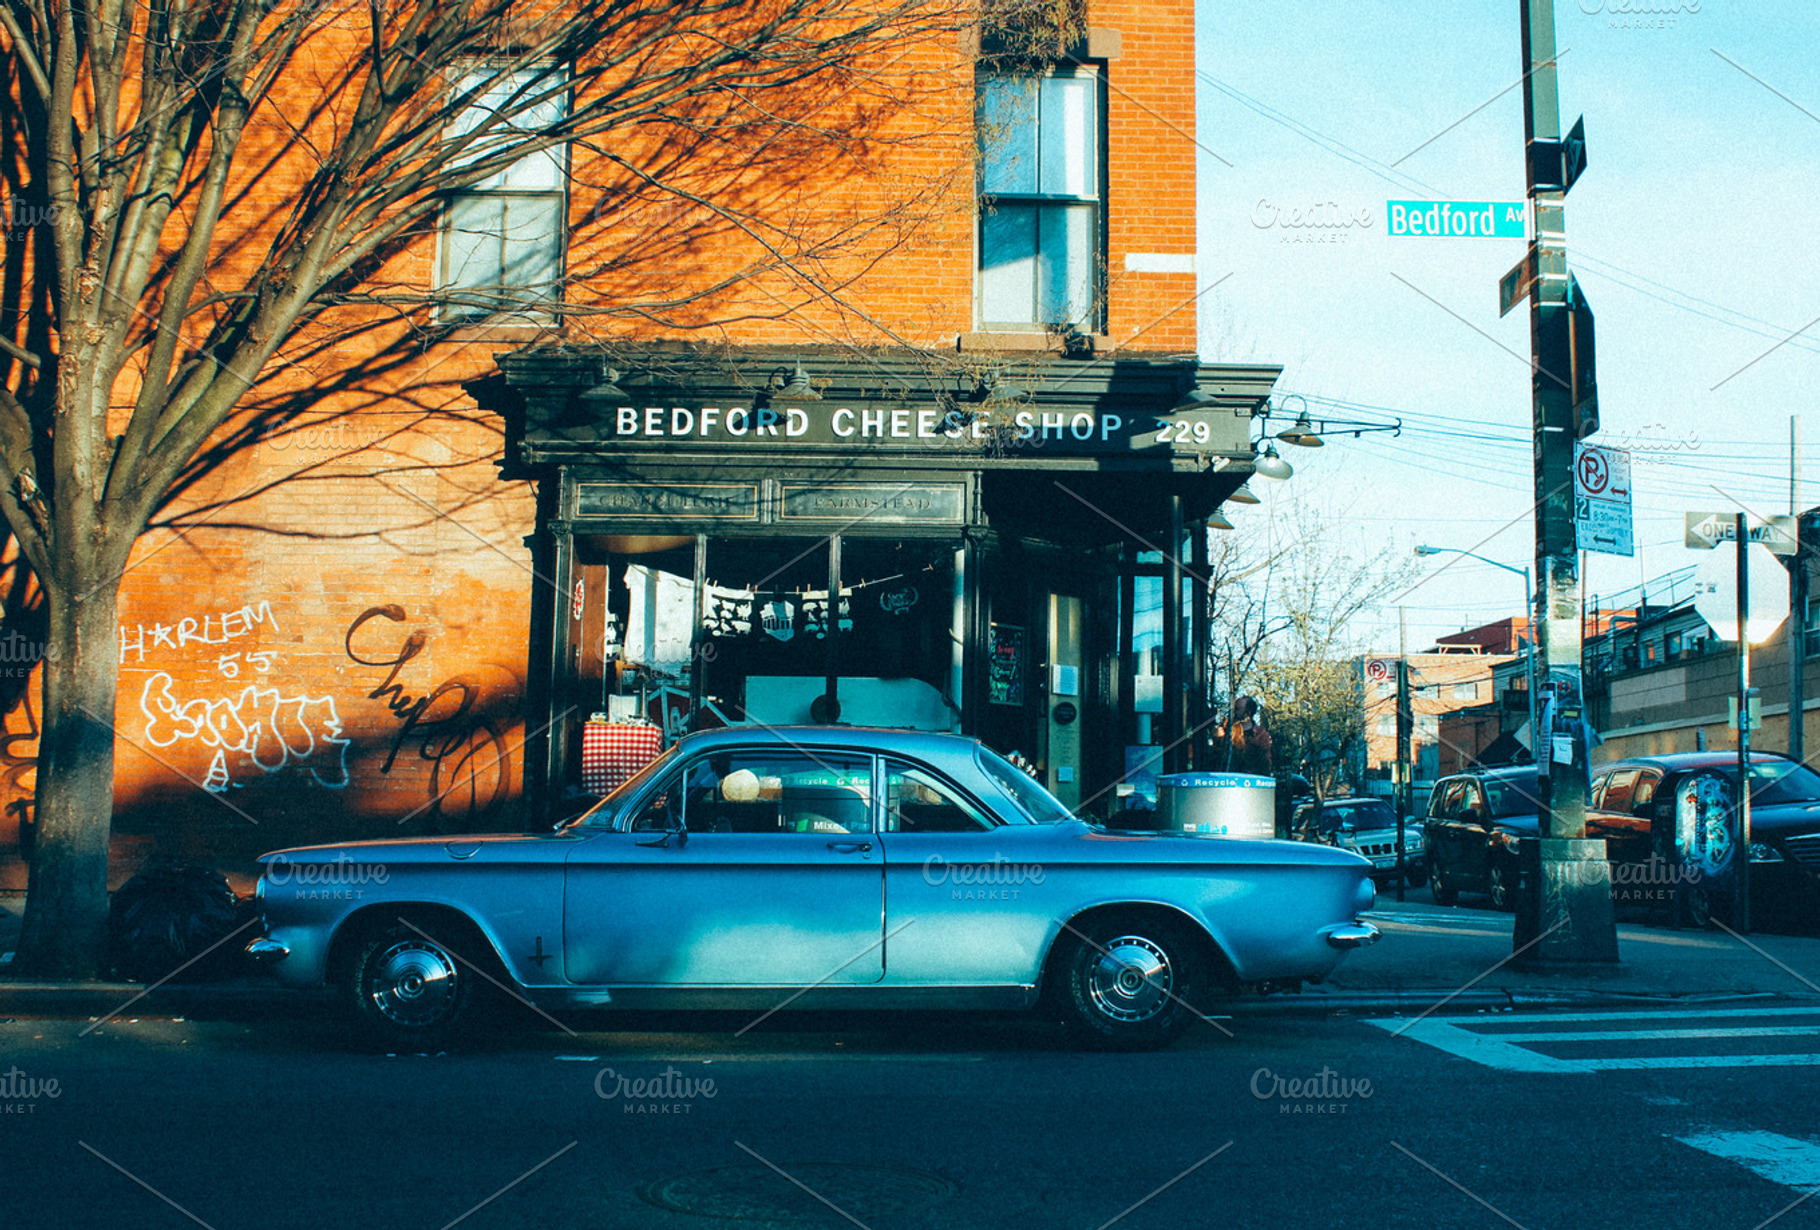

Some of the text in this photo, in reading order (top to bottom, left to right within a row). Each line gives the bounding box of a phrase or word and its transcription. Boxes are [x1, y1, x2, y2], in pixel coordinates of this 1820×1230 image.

[1392, 203, 1495, 235] Bedford
[617, 407, 1210, 444] BEDFORD CHEESE SHOP 229
[814, 497, 931, 510] FARMSTEAD
[1578, 498, 1588, 518] 2
[1702, 523, 1734, 539] ONE
[1195, 779, 1236, 787] Recycle
